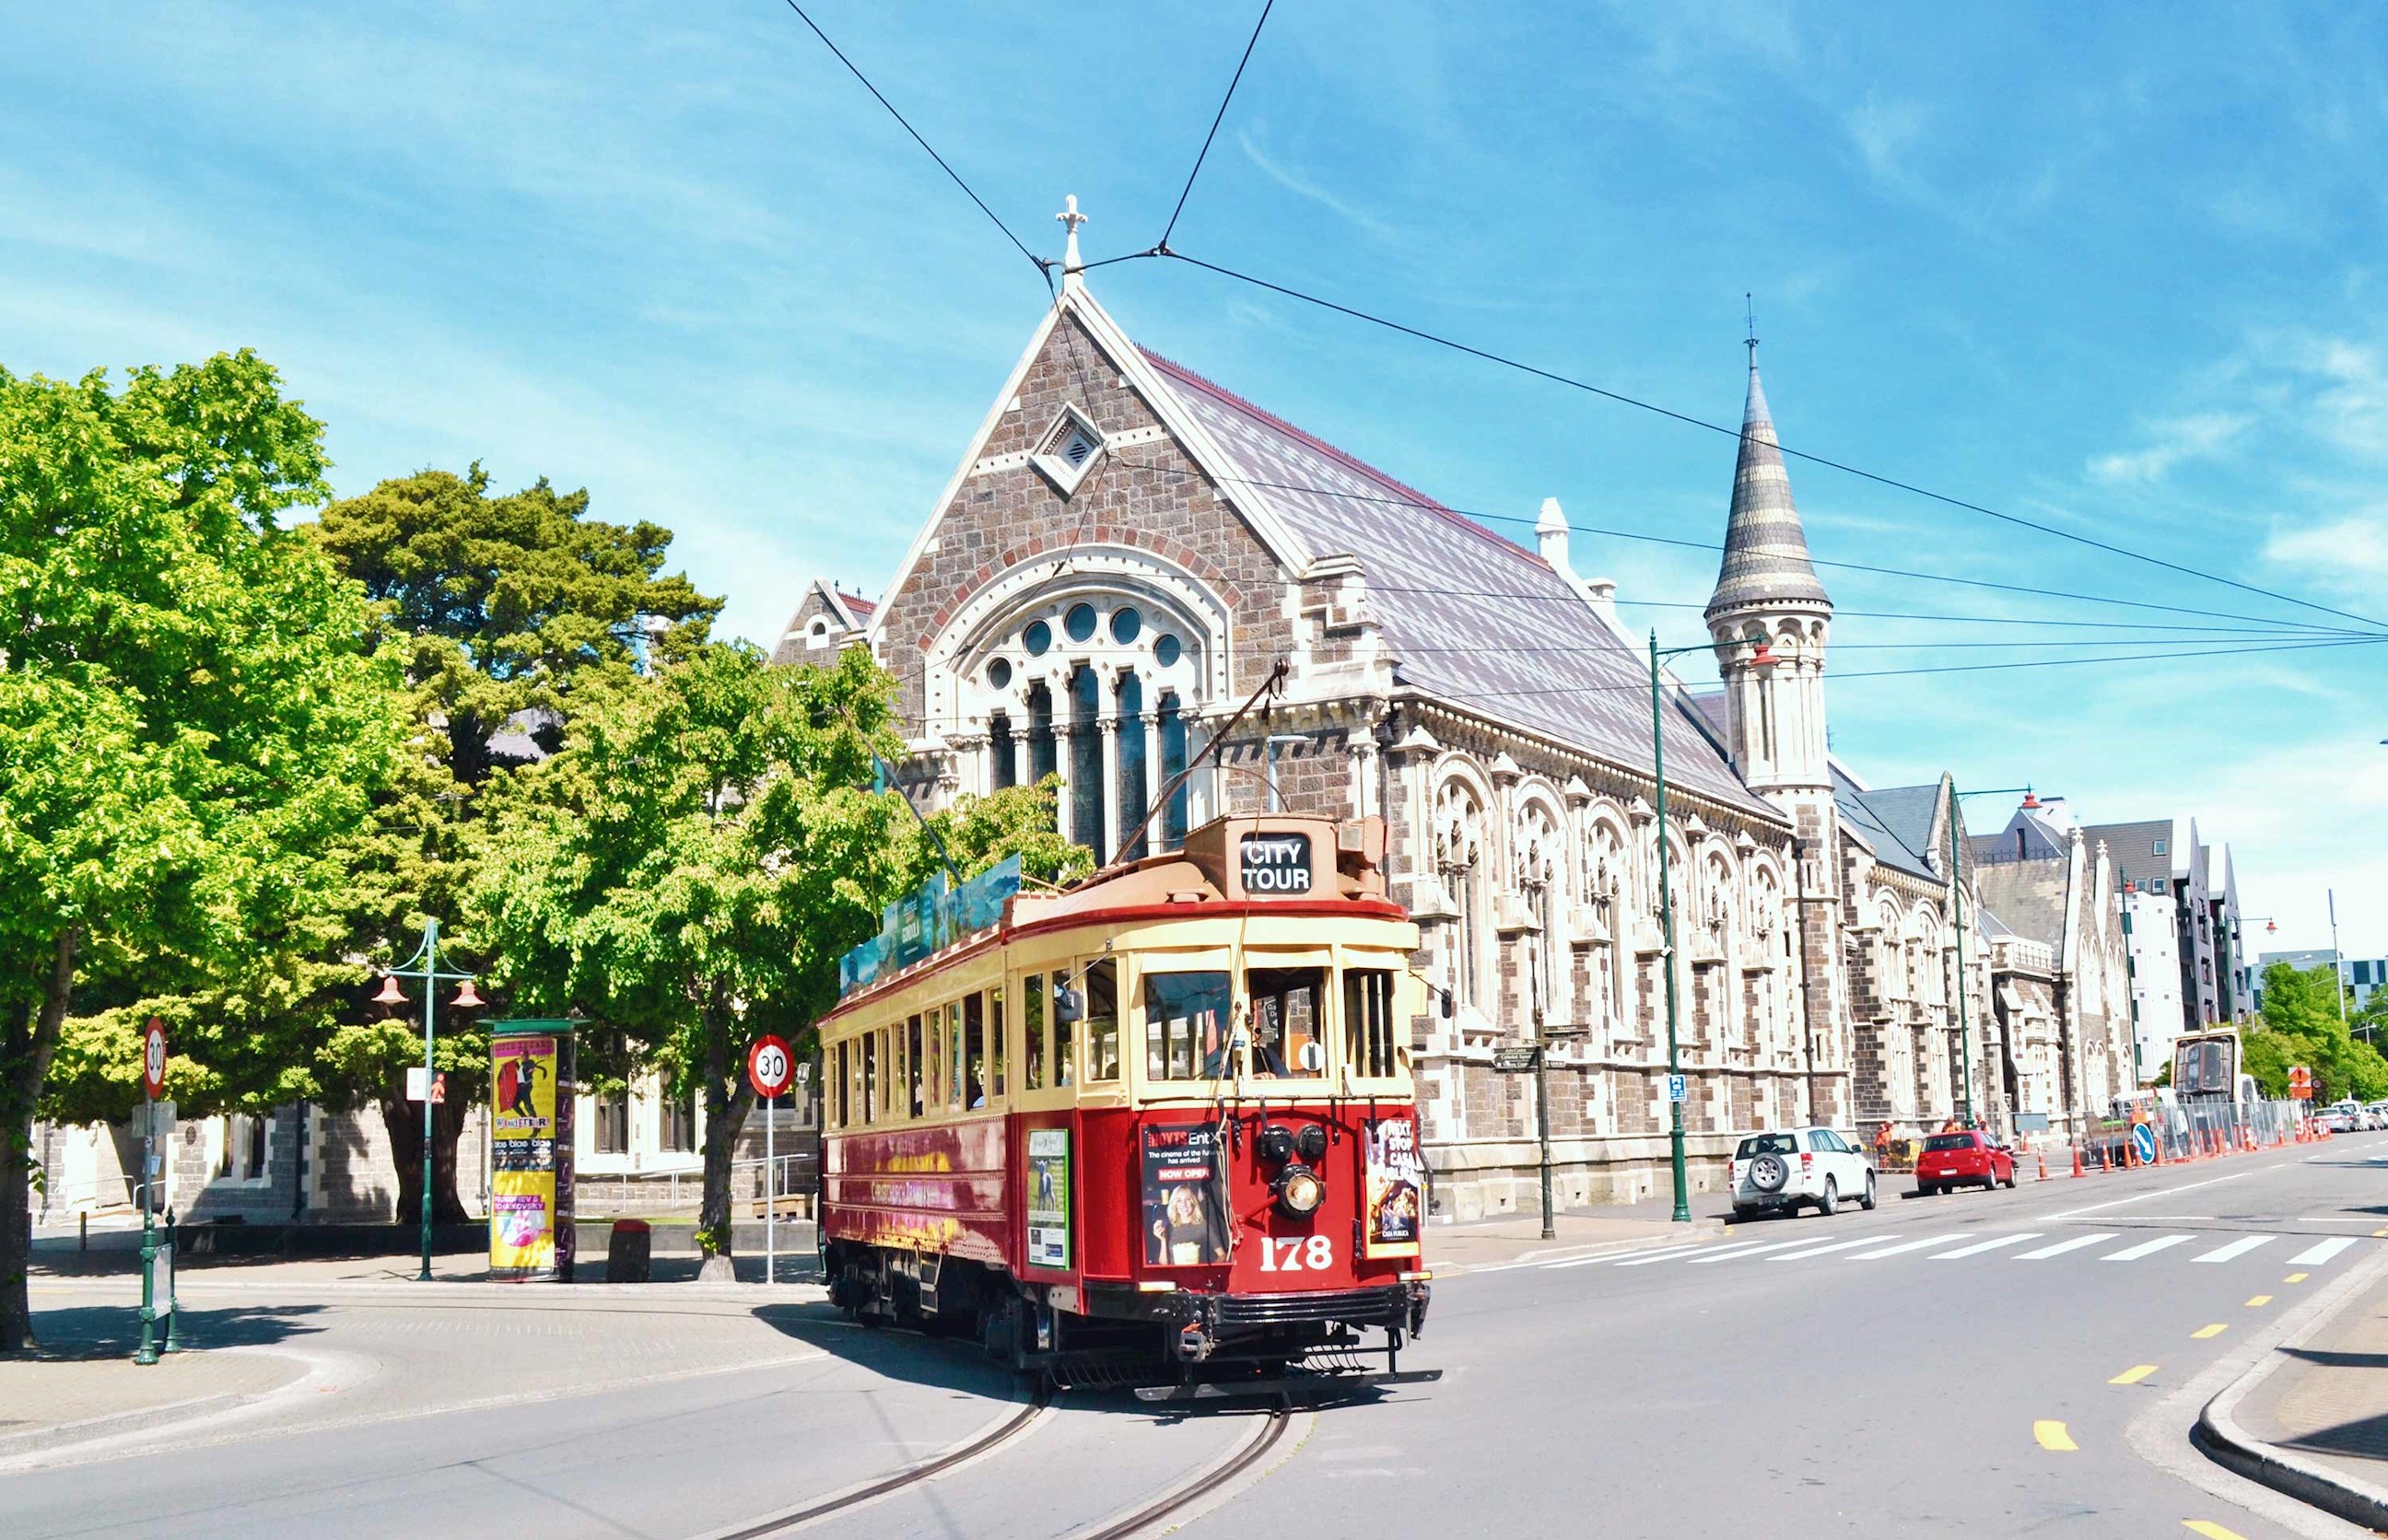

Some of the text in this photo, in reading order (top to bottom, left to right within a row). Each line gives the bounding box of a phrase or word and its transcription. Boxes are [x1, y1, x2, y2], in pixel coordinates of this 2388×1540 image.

[1247, 843, 1302, 865] CITY
[1242, 868, 1310, 890] TOUR
[148, 1042, 161, 1071] 30
[760, 1055, 784, 1077] 30
[1387, 1122, 1411, 1137] NEXT
[1148, 1131, 1188, 1148] HOYTS
[1388, 1137, 1412, 1150] STOP
[1390, 1151, 1415, 1166] CASA
[1161, 1169, 1209, 1179] NOW OPEN
[1259, 1234, 1333, 1272] 178
